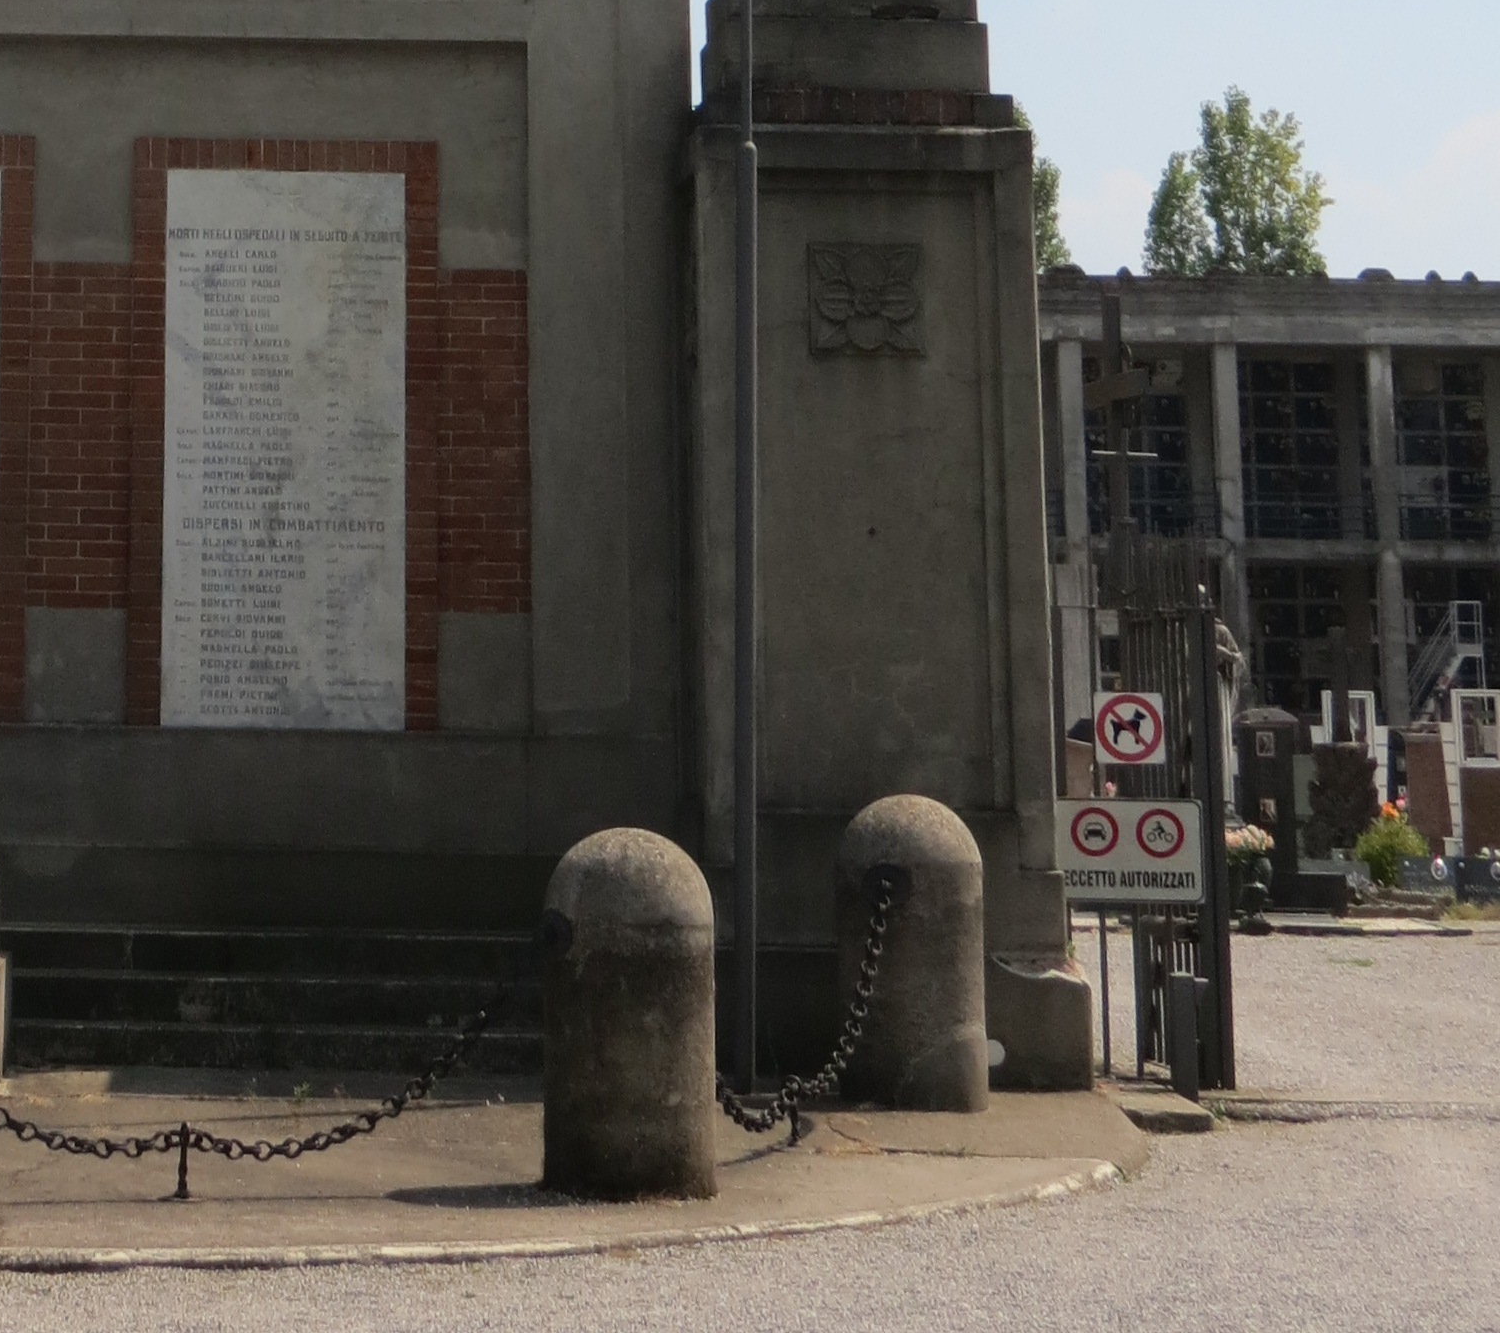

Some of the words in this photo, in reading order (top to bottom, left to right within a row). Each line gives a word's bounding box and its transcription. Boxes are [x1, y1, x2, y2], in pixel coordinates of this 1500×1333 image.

[169, 228, 200, 240] MORTI
[183, 518, 244, 531] DISPERSI
[248, 519, 262, 531] IN
[268, 518, 386, 533] COMBATTIMENTO
[1065, 869, 1117, 887] ECCETTO
[1120, 870, 1196, 889] AUTORIZZATI
